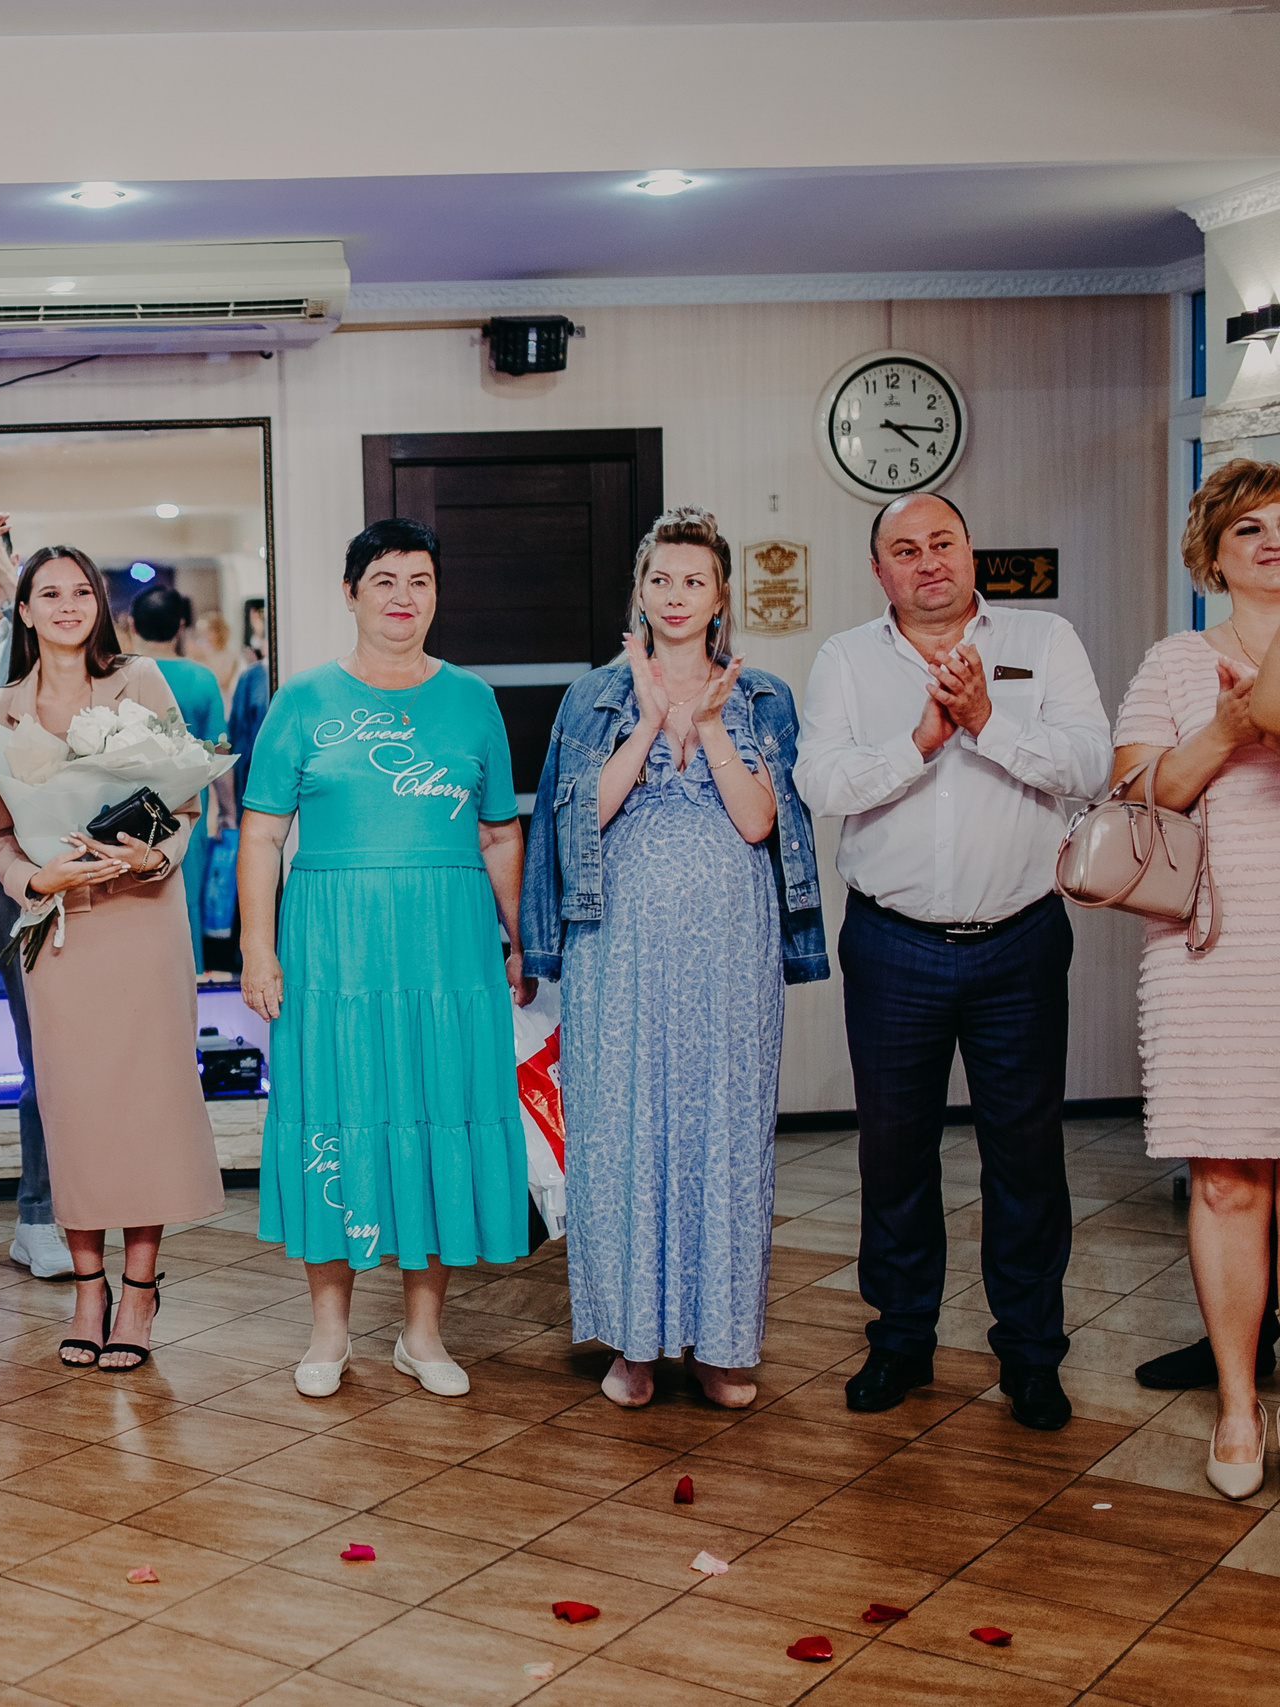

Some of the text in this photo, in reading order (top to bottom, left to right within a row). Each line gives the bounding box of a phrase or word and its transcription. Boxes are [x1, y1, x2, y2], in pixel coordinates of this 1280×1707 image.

[865, 380, 877, 394] 11
[885, 373, 900, 389] 12
[911, 379, 917, 394] 1
[927, 394, 938, 410] 2
[841, 420, 852, 436] 9
[934, 417, 944, 433] 3
[926, 441, 937, 457] 4
[868, 460, 877, 475] 7
[888, 464, 899, 480] 6
[910, 458, 919, 474] 5
[987, 555, 1027, 576] WC
[314, 708, 415, 748] Sweet
[369, 742, 471, 820] Cherry
[304, 1133, 340, 1173] Swe
